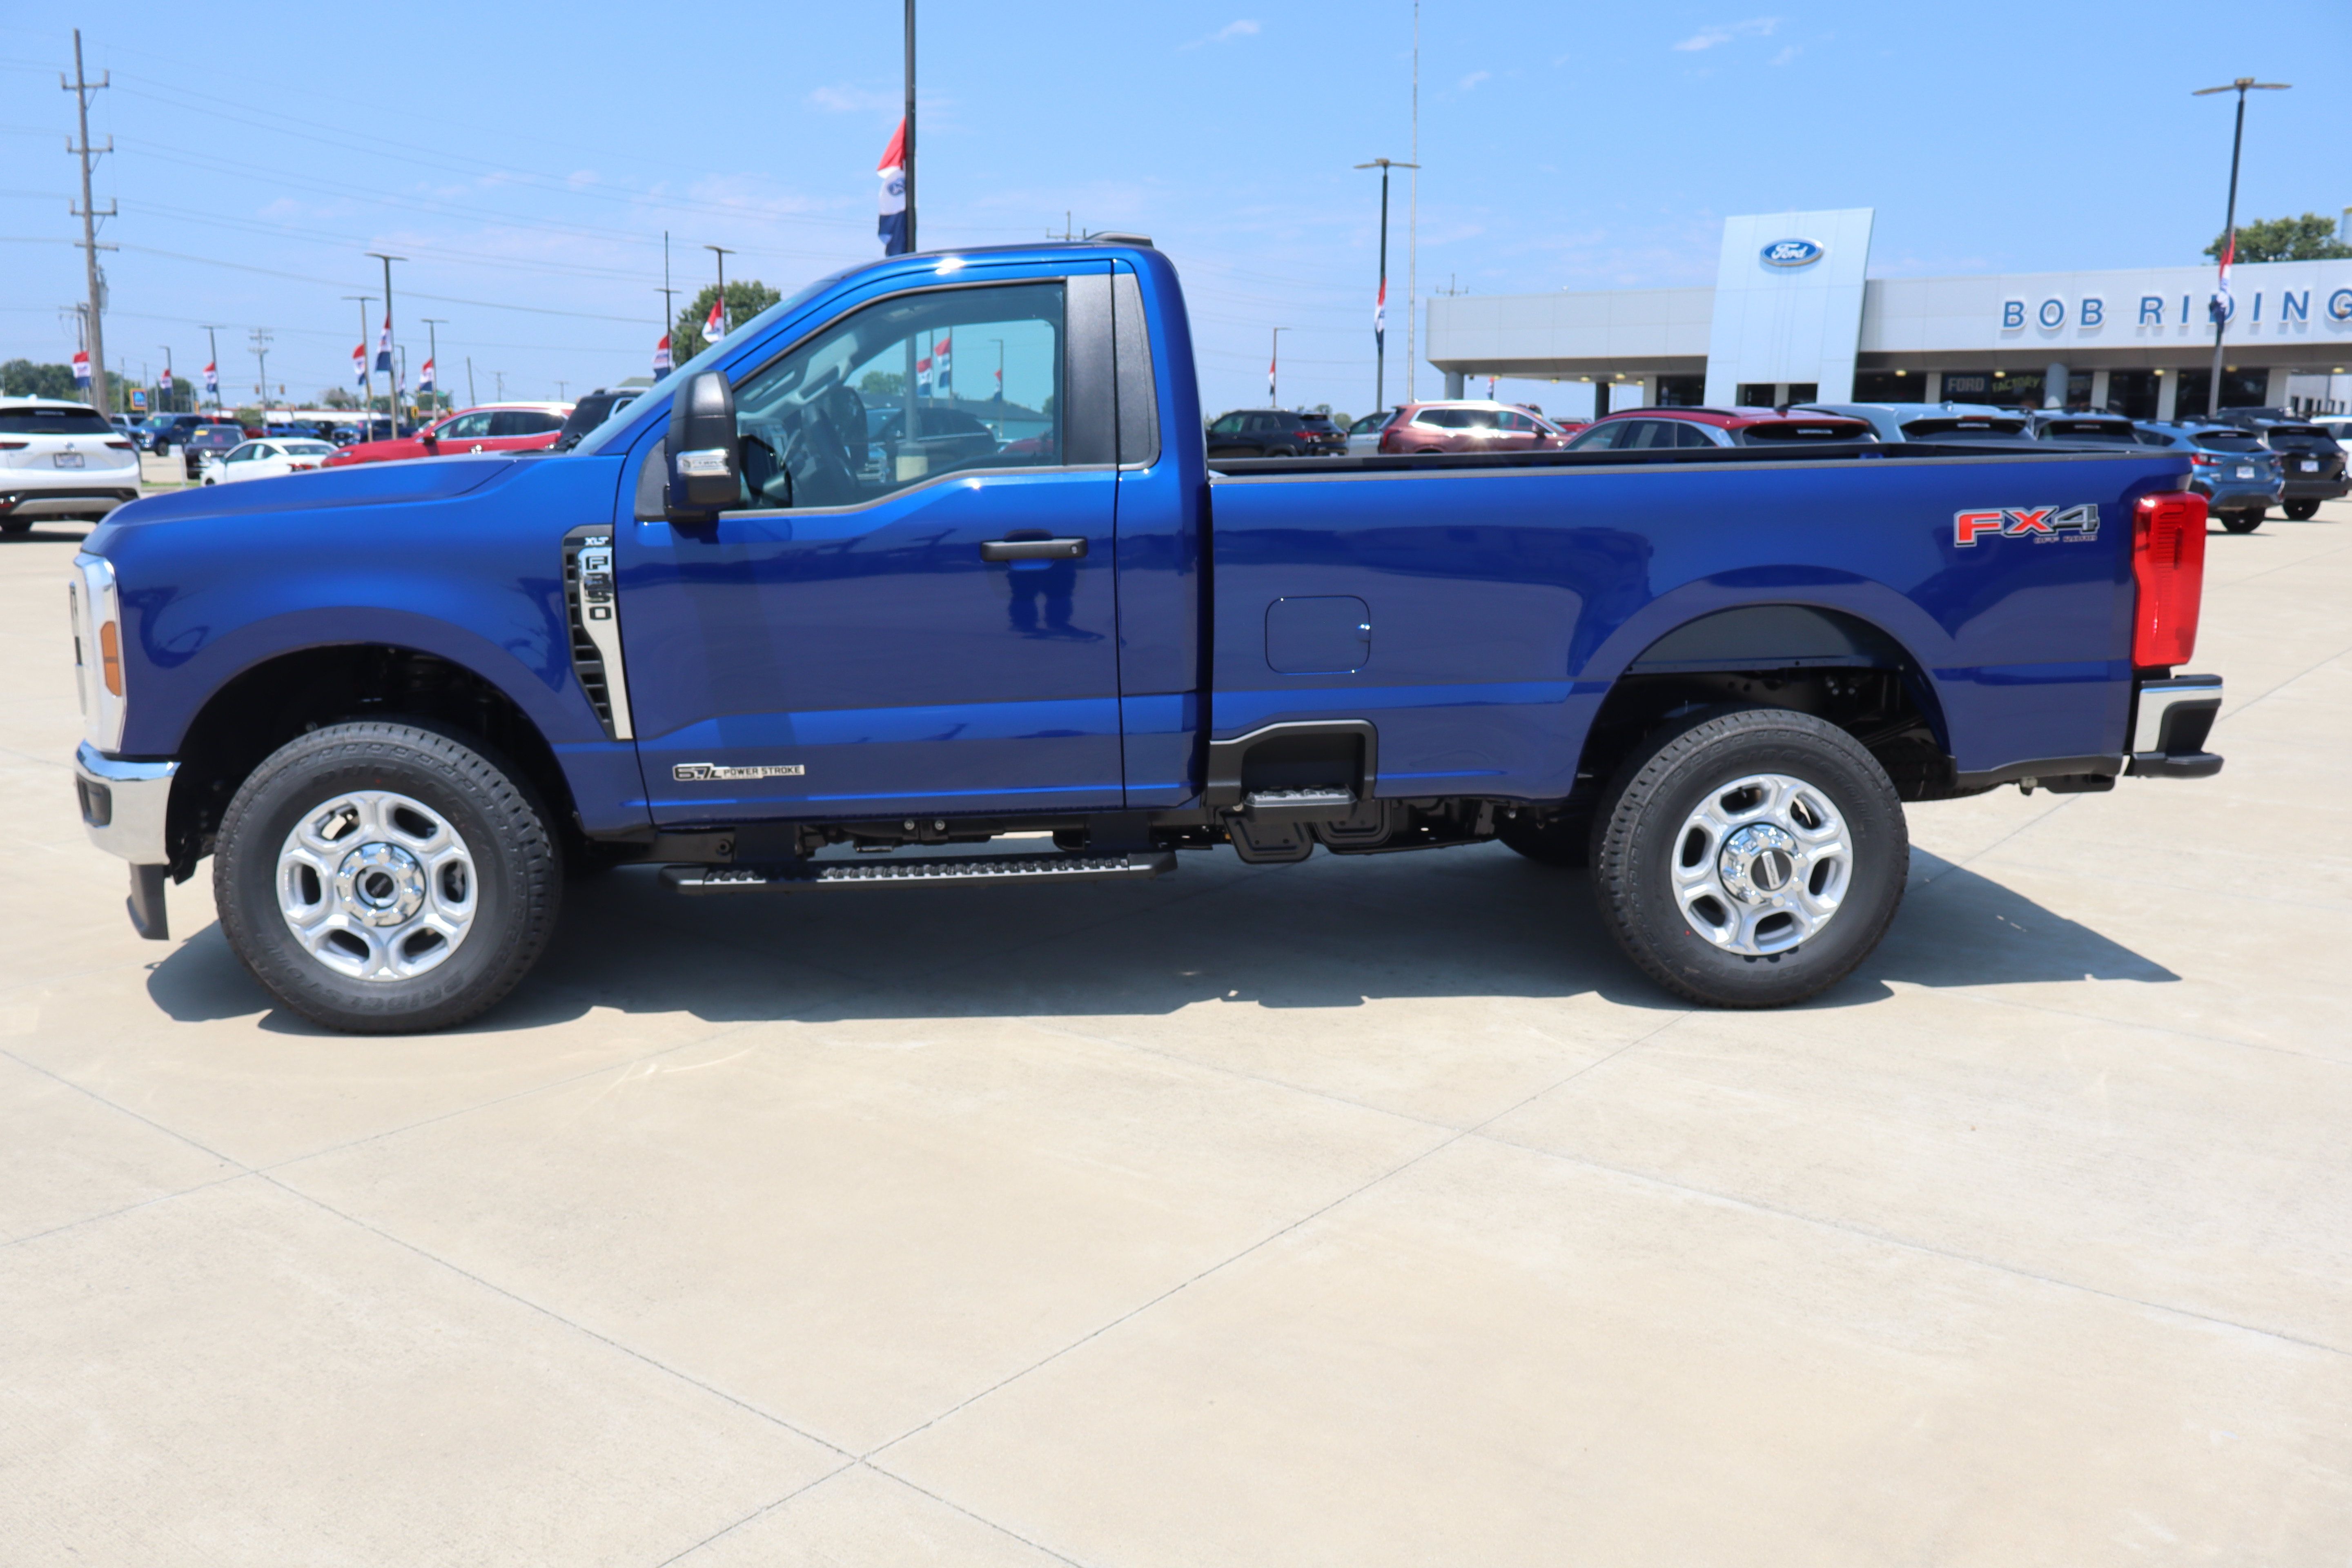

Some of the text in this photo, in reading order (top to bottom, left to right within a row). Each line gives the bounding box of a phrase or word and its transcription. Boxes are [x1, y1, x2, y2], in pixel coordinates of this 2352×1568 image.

[1771, 243, 1809, 260] Ford
[2002, 298, 2106, 328] BOB
[1947, 376, 1985, 392] FORD
[1954, 503, 2100, 548] FX4
[584, 536, 609, 546] XLT
[761, 766, 800, 775] STROKE
